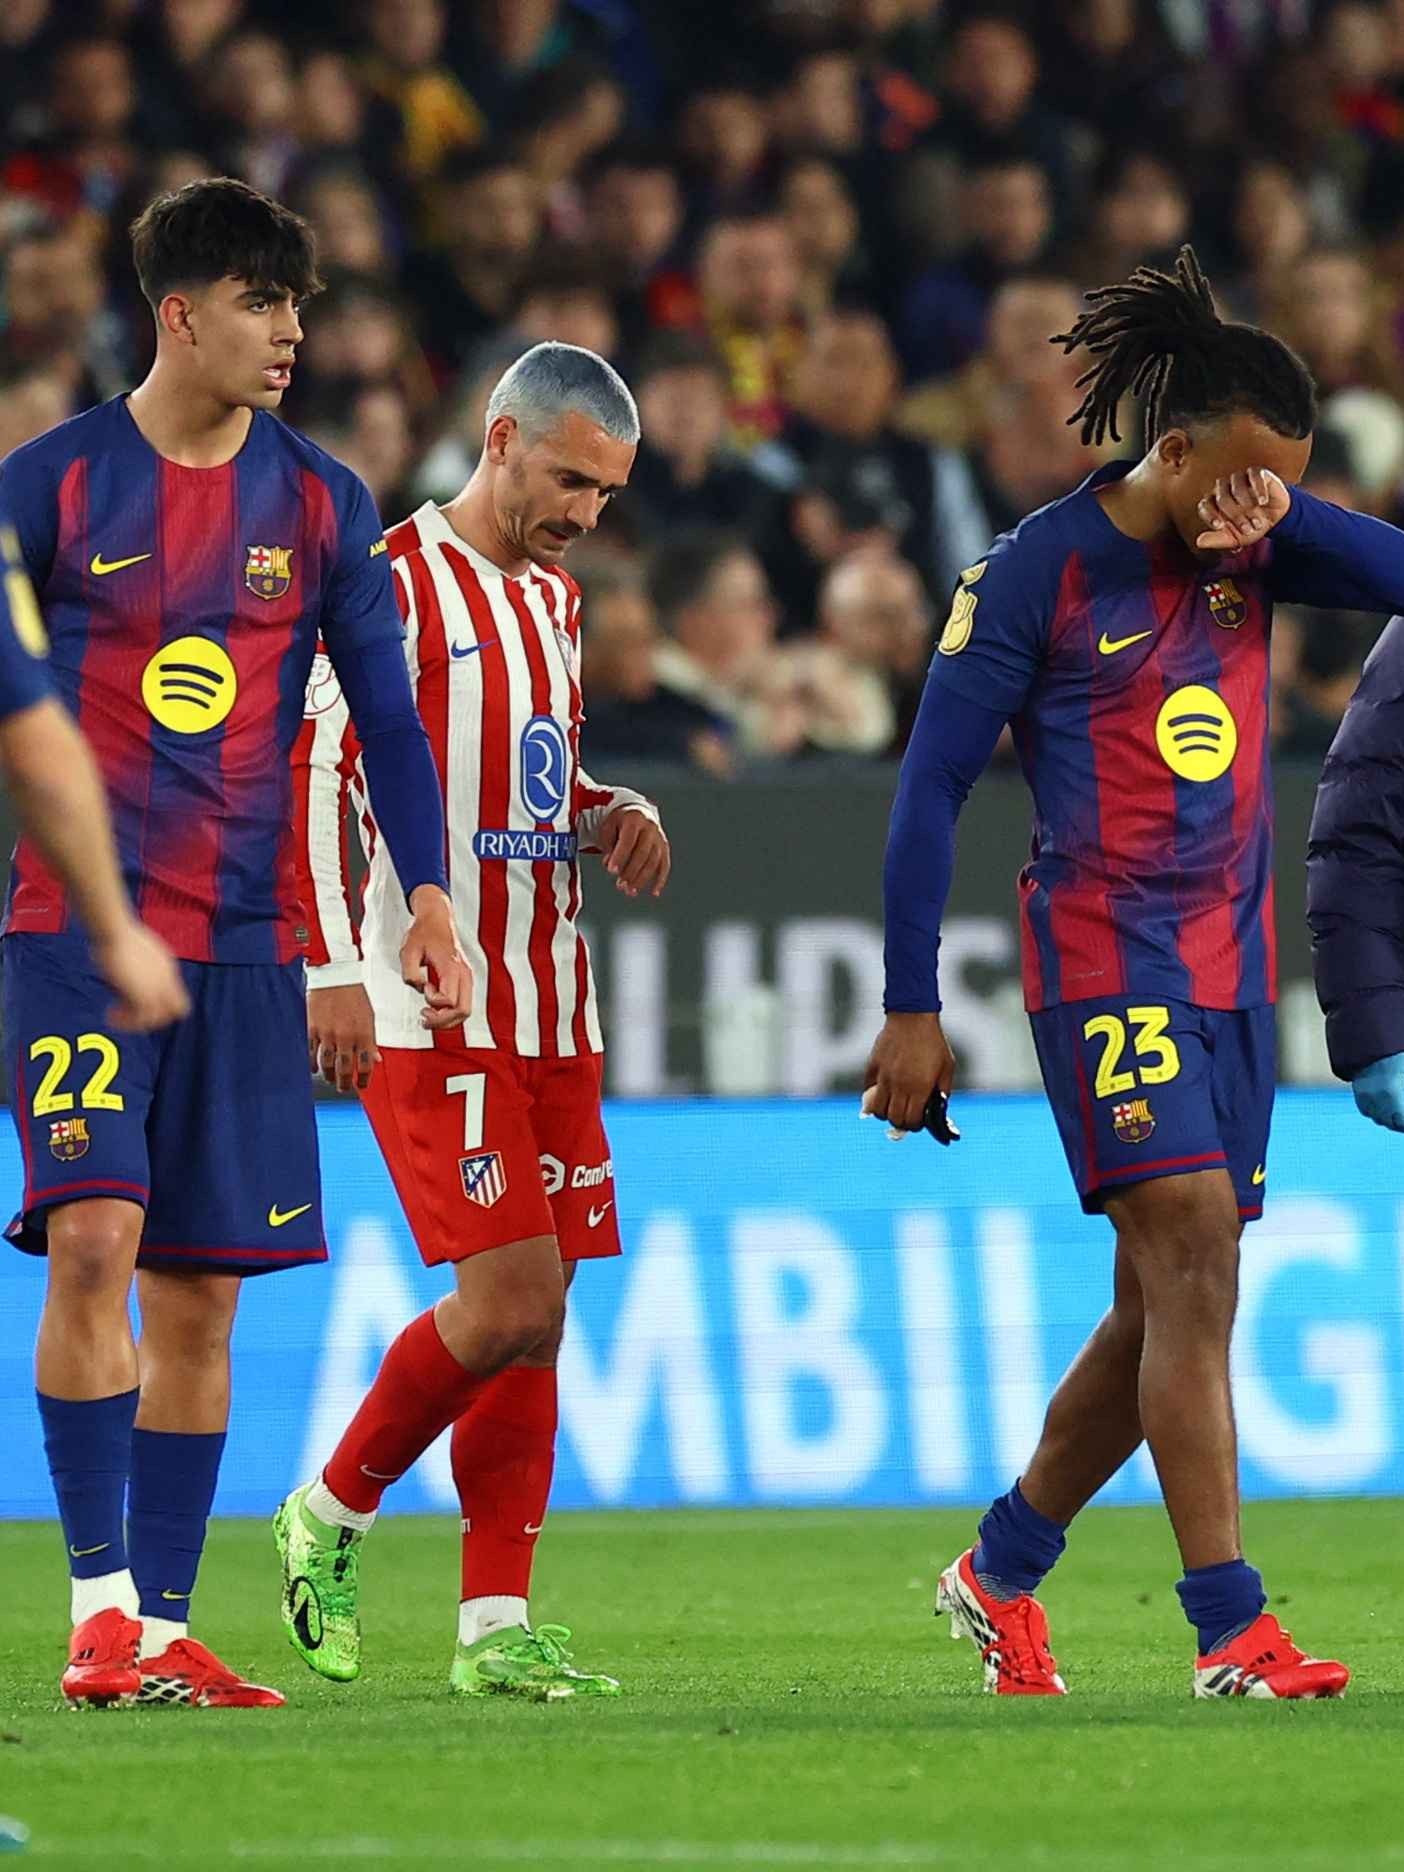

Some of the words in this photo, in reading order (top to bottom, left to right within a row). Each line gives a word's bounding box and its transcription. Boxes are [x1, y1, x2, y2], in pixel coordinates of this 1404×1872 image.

[479, 832, 559, 858] RIYADH
[30, 1032, 124, 1117] 22
[1083, 1006, 1180, 1098] 23
[446, 1073, 487, 1151] 7
